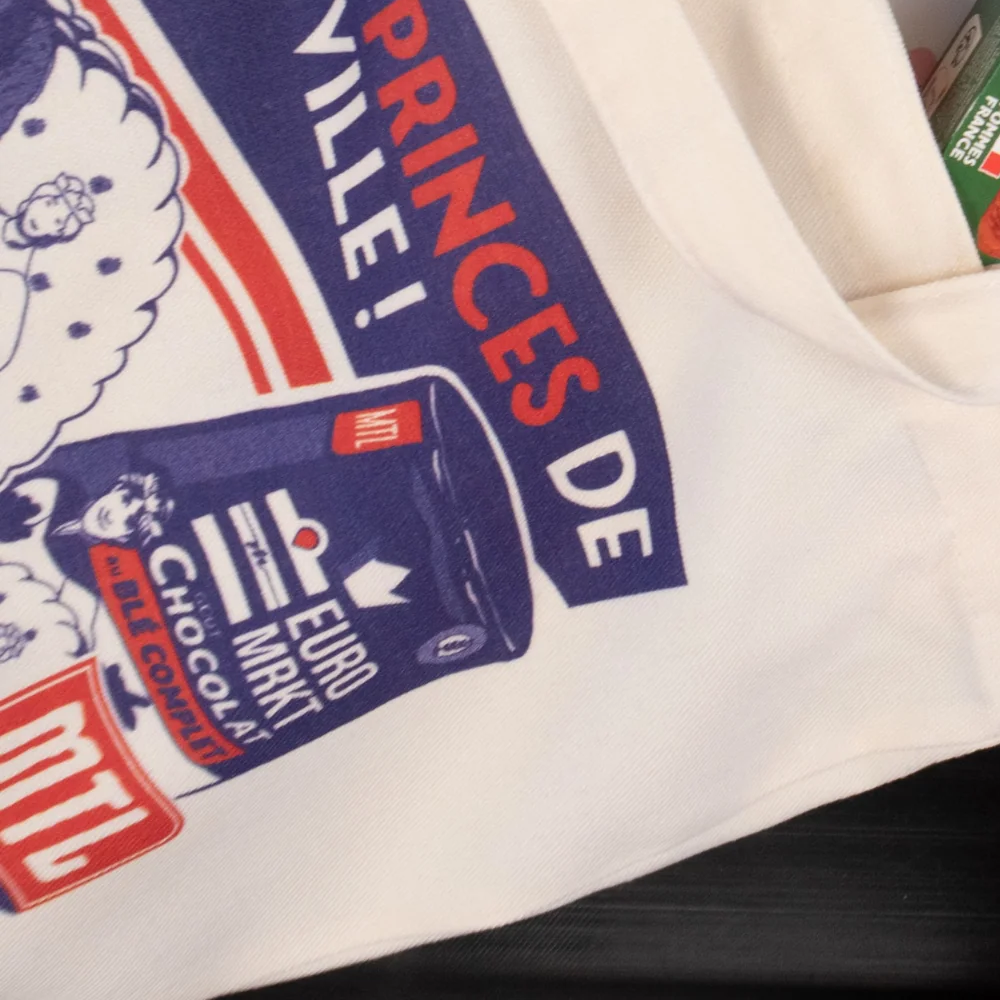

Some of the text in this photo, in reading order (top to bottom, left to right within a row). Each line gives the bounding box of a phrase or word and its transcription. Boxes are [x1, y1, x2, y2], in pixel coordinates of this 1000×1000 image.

[949, 95, 999, 162] FRANCE
[353, 280, 428, 329] !
[354, 407, 399, 449] MTL
[545, 429, 654, 569] DE
[112, 579, 162, 638] BLÉ
[140, 643, 230, 760] COMPLET
[150, 543, 273, 745] CHOCOLAT
[231, 622, 325, 731] MRKT
[285, 599, 380, 702] EURO
